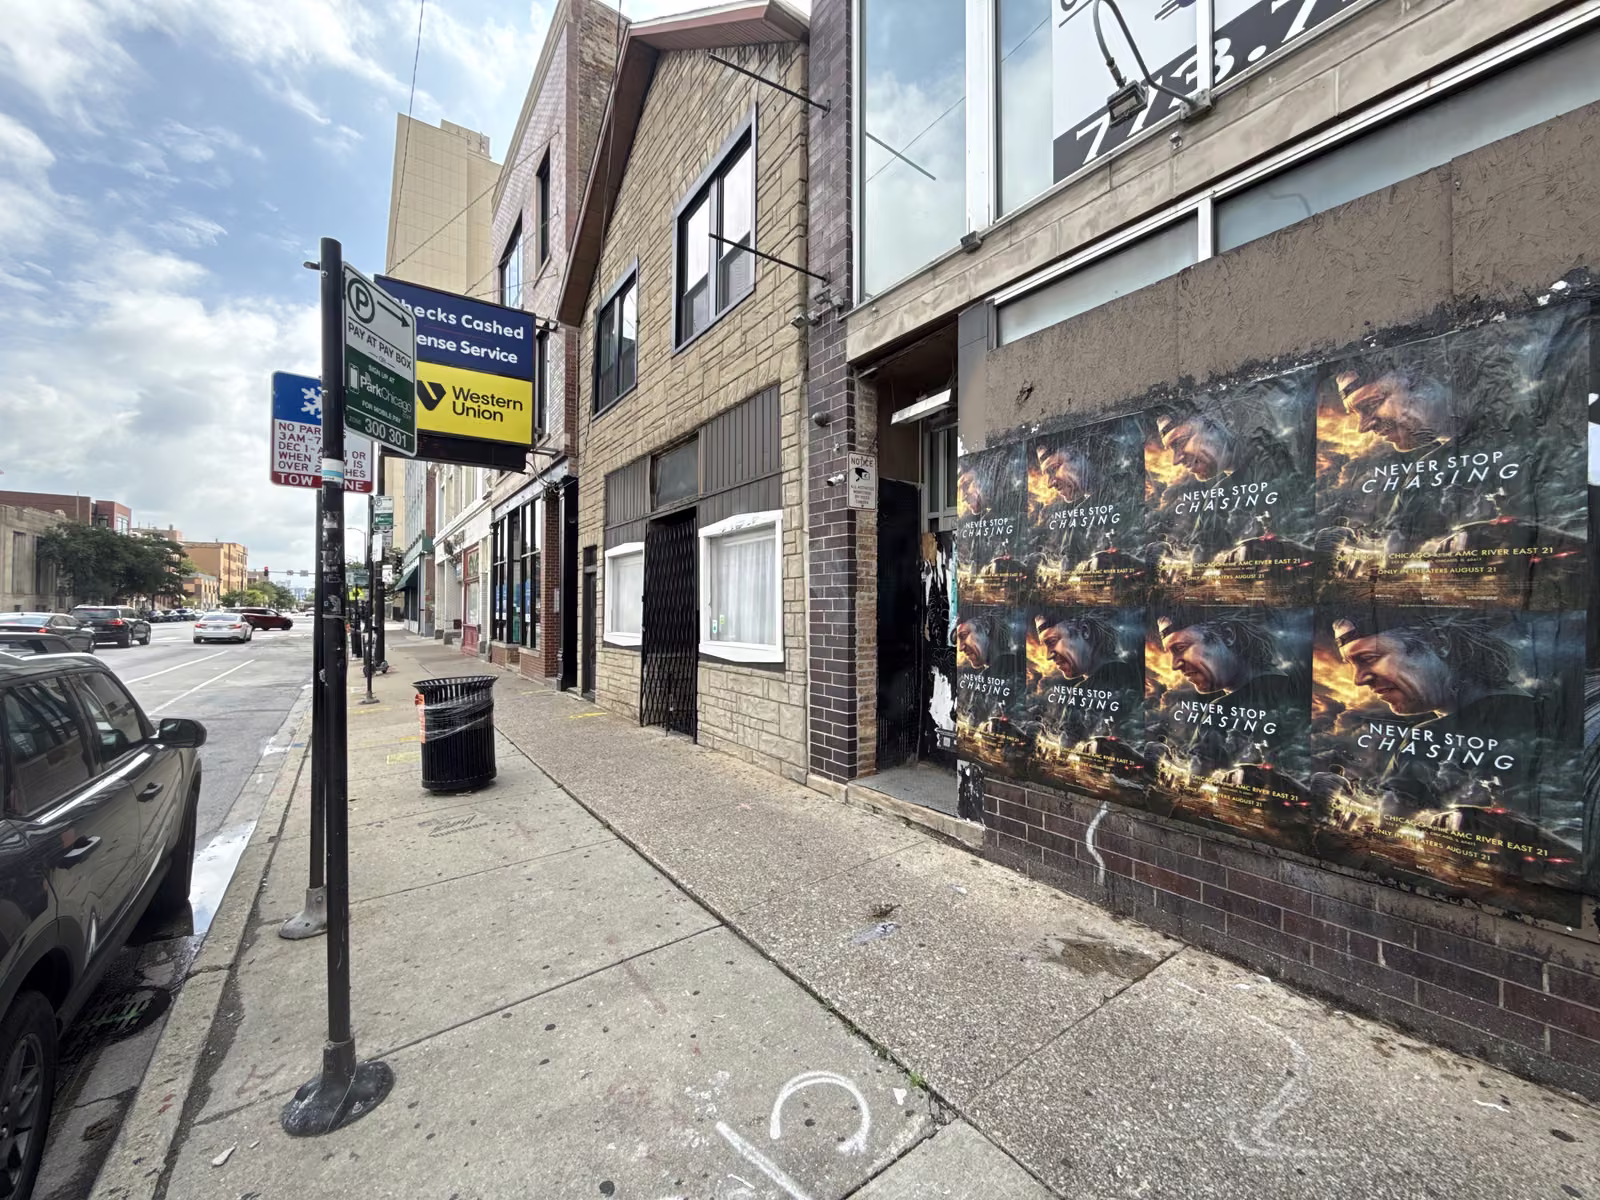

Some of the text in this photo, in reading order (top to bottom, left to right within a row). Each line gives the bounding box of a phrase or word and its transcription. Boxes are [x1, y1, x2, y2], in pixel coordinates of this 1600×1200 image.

[392, 298, 524, 340] hecks Cashed
[348, 321, 412, 371] PAY AT PAY BOX
[416, 334, 518, 364] ense Service
[452, 385, 524, 411] Western
[361, 400, 373, 411] FOR
[373, 405, 392, 420] MOBILE
[452, 400, 504, 422] Union
[278, 422, 295, 432] NO
[365, 418, 407, 448] 300 301
[278, 441, 300, 452] DEC
[352, 451, 366, 460] OR
[278, 451, 312, 462] WHEN
[353, 460, 363, 469] IS
[278, 460, 309, 471] OVER
[314, 465, 322, 473] 2
[850, 456, 873, 468] NOTICE
[1374, 451, 1504, 477] NEVER STOP
[278, 473, 314, 486] TOW
[1361, 464, 1520, 494] CHASING
[1183, 482, 1268, 502] NEVER STOP
[1054, 505, 1114, 519] NEVER STOP
[1175, 492, 1278, 515] CHASING
[962, 525, 1013, 538] CHASING
[965, 518, 1009, 528] NEVER STOP
[1049, 513, 1121, 530] CHASING
[1481, 548, 1509, 556] RIVER
[1512, 547, 1538, 555] EAST
[959, 680, 1010, 697] CHASING
[963, 673, 1005, 686] NEVER STOP
[1053, 685, 1113, 699] NEVER STOP
[1048, 693, 1120, 712] CHASING
[1181, 700, 1266, 720] NEVER STOP
[1173, 710, 1277, 735] CHASING
[1369, 722, 1499, 751] NEVER STOP
[1357, 734, 1515, 770] CHASING
[1235, 784, 1251, 792] AMC
[1252, 786, 1270, 795] RIVER
[1272, 791, 1289, 800] EAST
[1372, 827, 1392, 836] ONLY
[1446, 845, 1478, 858] AUGUST
[1481, 853, 1491, 861] 21
[1383, 814, 1426, 827] CHICAGO
[1450, 829, 1472, 840] AMC
[1475, 834, 1504, 847] RIVER
[1507, 841, 1533, 853] EAST
[1536, 848, 1548, 857] 21
